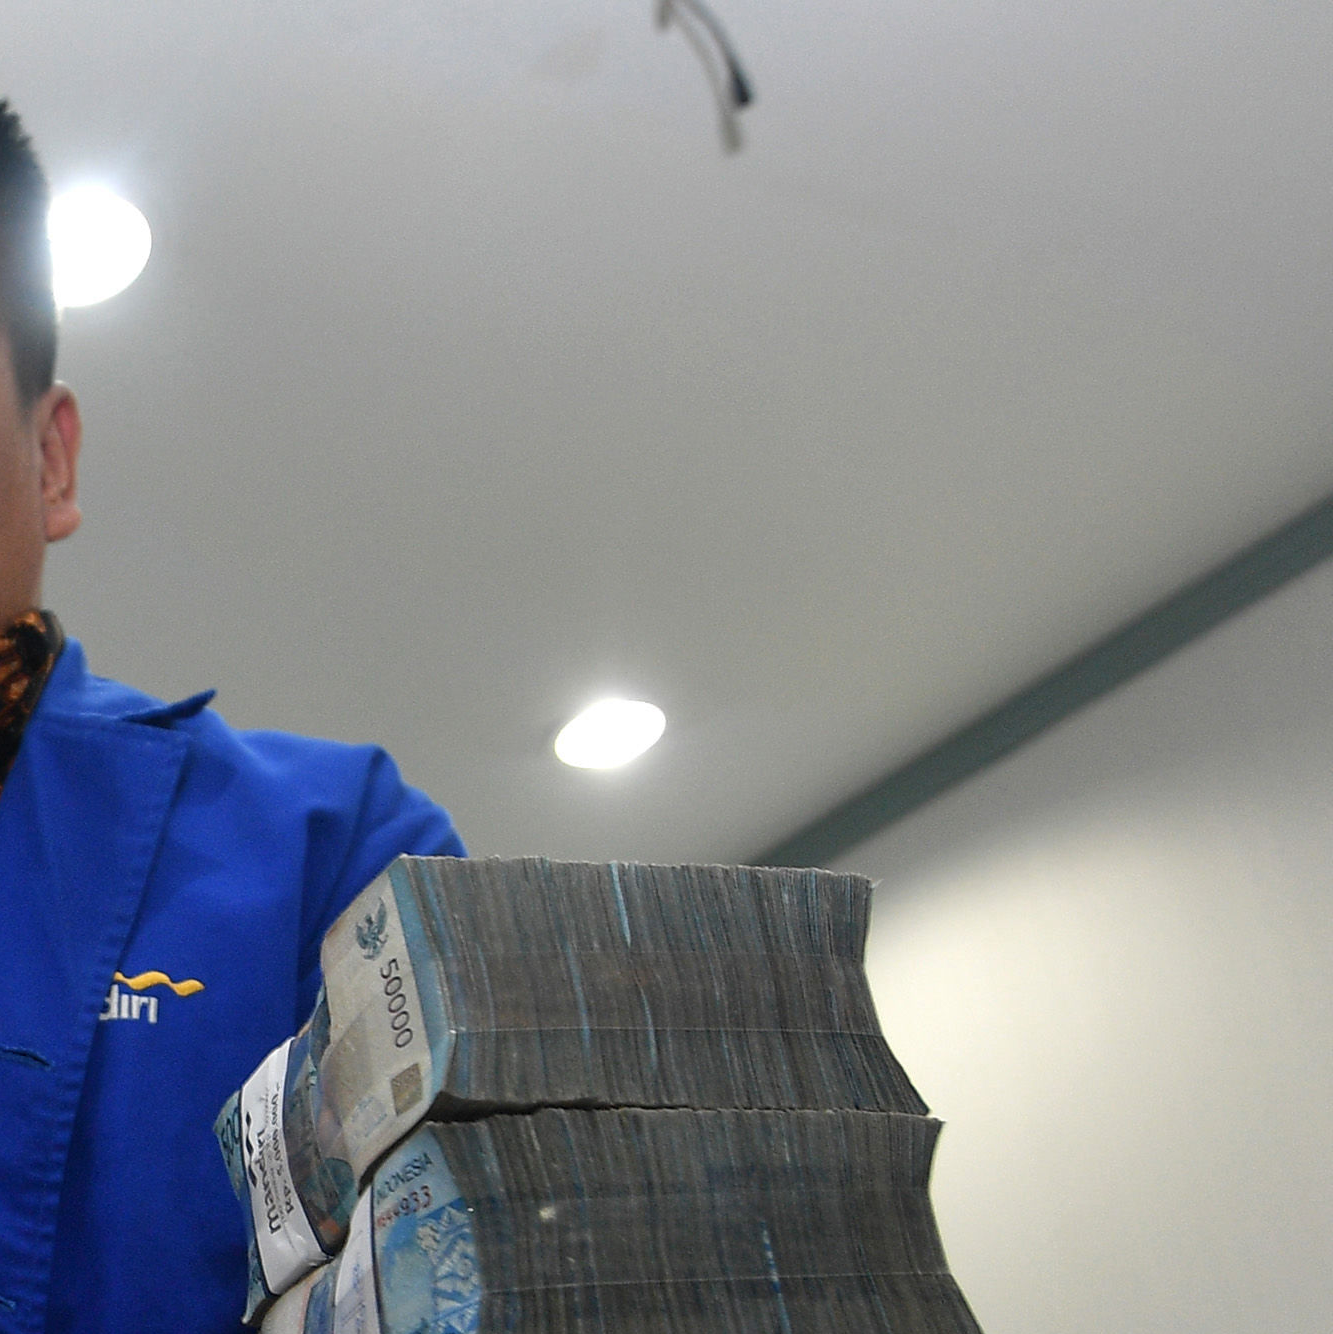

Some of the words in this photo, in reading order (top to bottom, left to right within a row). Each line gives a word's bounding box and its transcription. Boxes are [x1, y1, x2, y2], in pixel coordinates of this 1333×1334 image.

[99, 984, 158, 1024] diri
[379, 957, 414, 1049] 50000
[255, 1130, 282, 1235] mandiri
